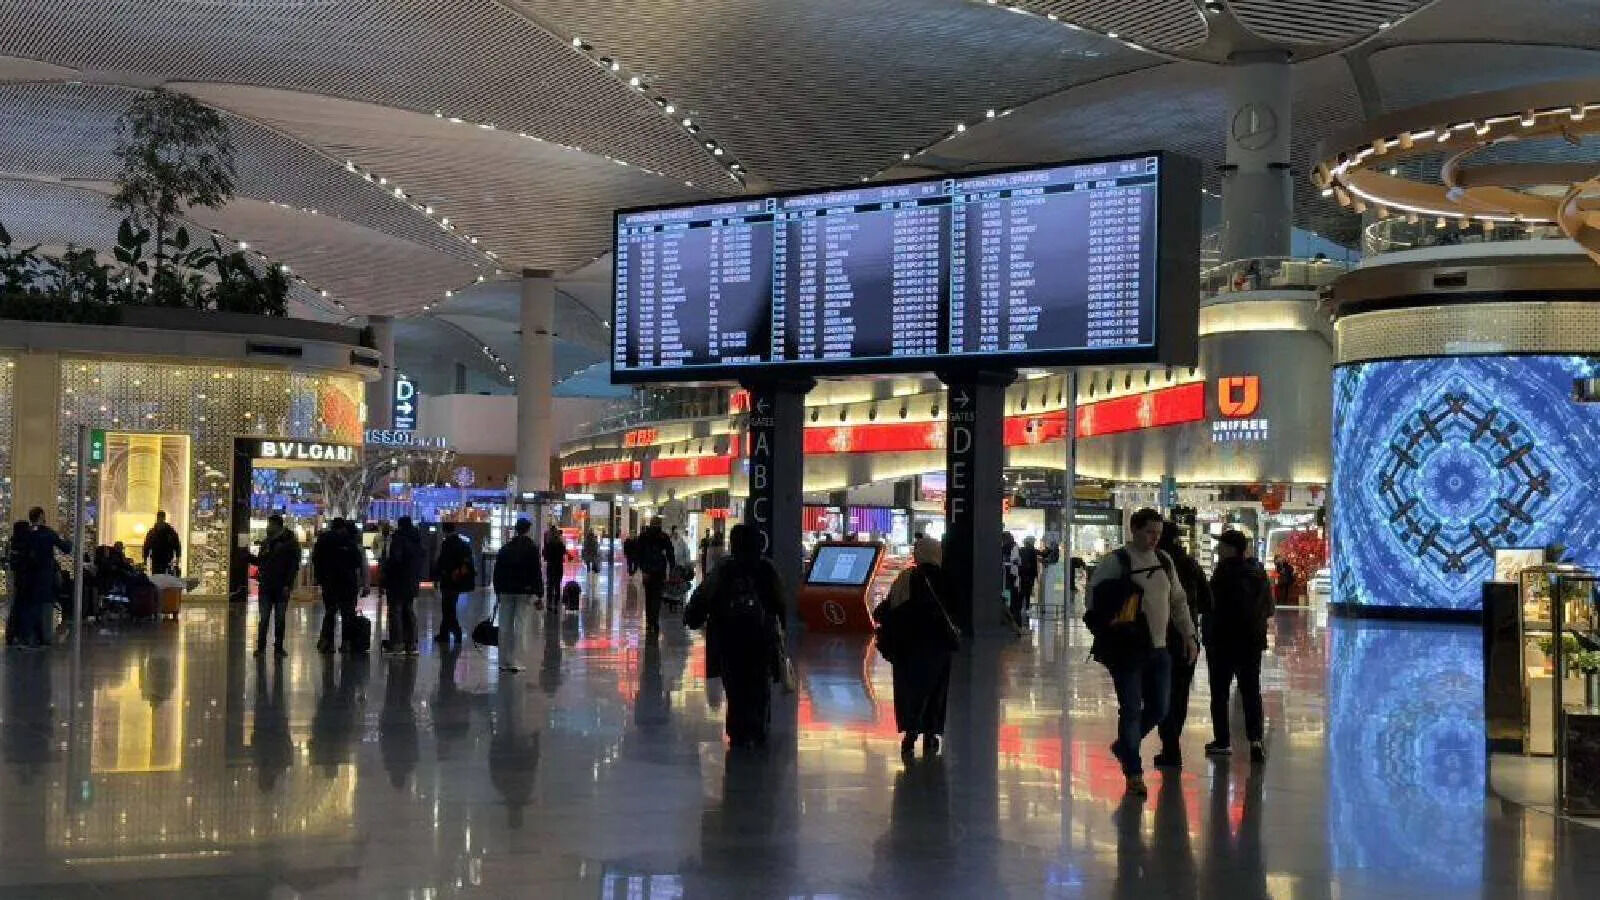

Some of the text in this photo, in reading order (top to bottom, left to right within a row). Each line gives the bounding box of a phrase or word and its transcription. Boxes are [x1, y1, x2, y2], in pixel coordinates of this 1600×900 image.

[397, 380, 413, 401] D
[1213, 418, 1268, 430] UNIFREE
[262, 441, 352, 461] BVLGARI
[756, 431, 769, 456] A
[953, 426, 972, 454] D
[754, 464, 767, 489] B
[953, 461, 966, 489] E
[753, 497, 768, 523] C
[951, 498, 965, 523] F
